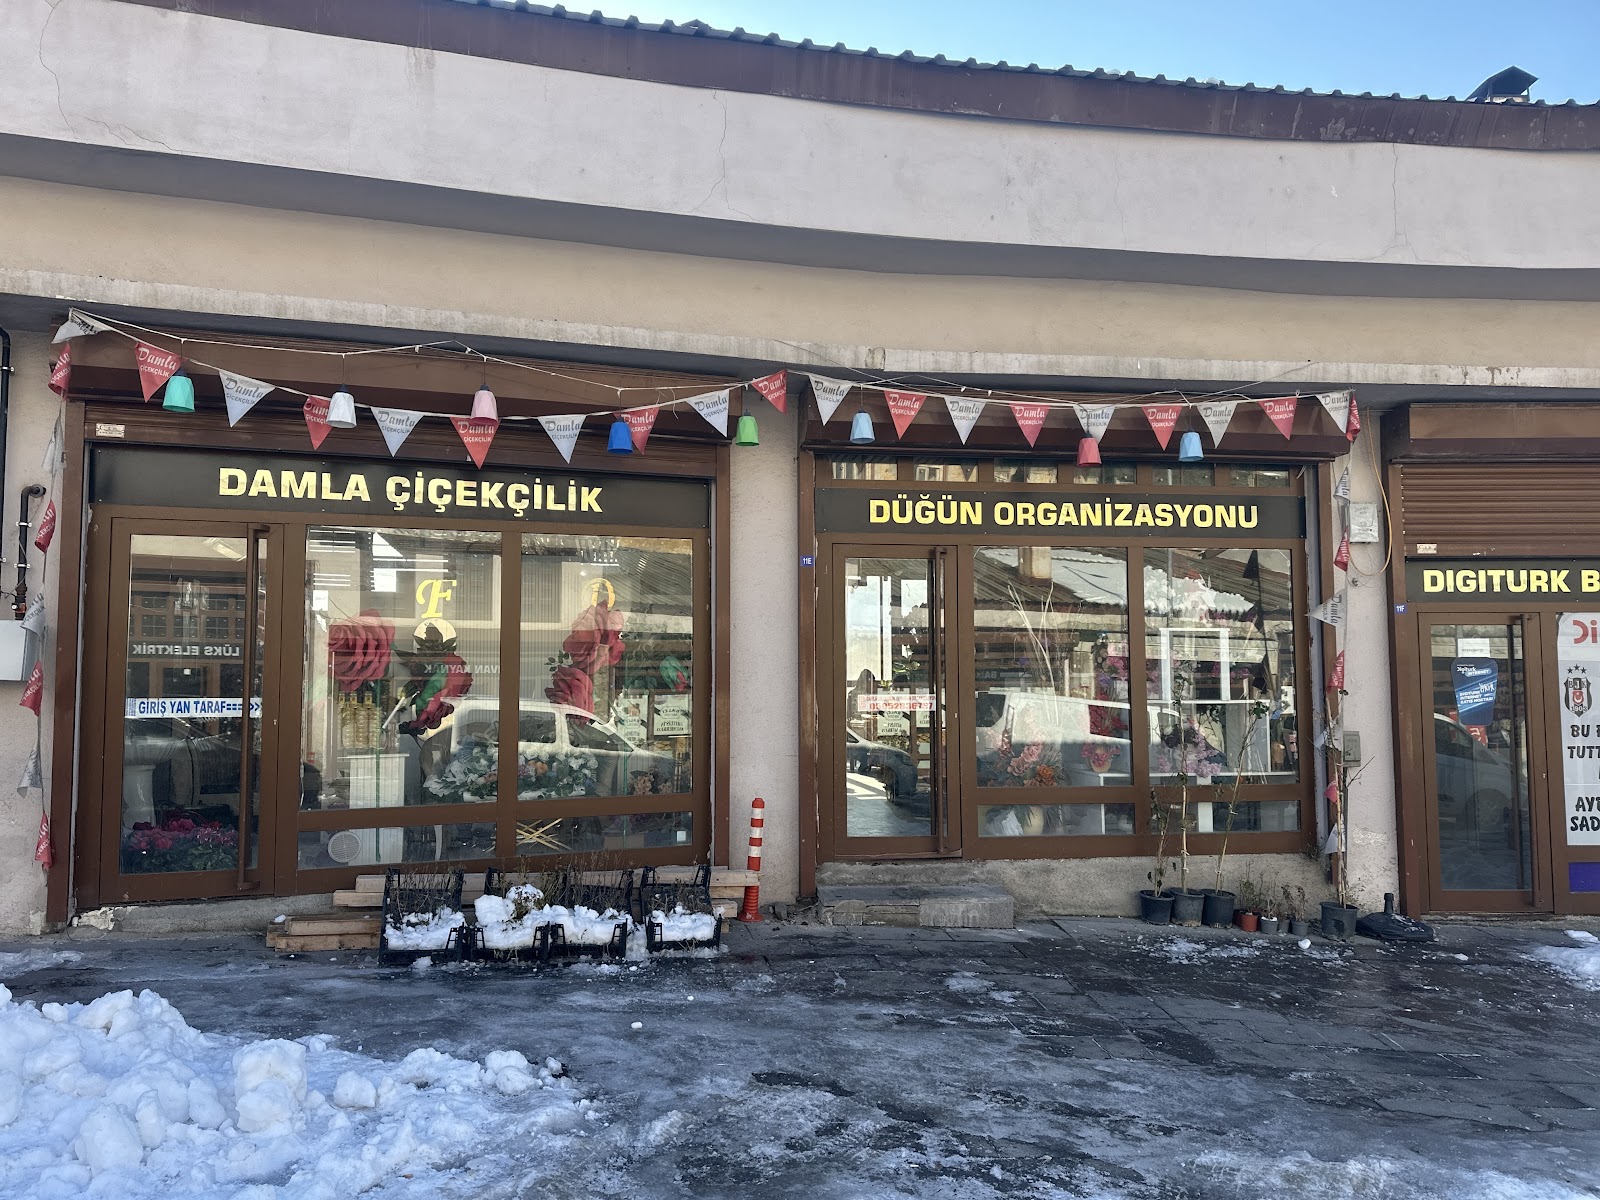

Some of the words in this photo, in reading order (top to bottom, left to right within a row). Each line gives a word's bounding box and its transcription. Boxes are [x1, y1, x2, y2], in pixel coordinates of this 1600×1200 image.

[138, 347, 177, 371] Damla
[225, 377, 265, 399] Damla
[814, 380, 845, 397] Damla
[303, 397, 329, 416] Dam
[695, 395, 728, 412] Damla
[889, 393, 920, 409] Damla
[950, 400, 980, 414] Damla
[1263, 401, 1295, 413] Damla
[377, 410, 416, 427] Damla
[1014, 405, 1046, 419] Damla
[1148, 408, 1177, 420] Damla
[1203, 406, 1232, 418] Damla
[457, 421, 495, 434] Damla
[545, 420, 580, 432] Damla
[219, 467, 370, 502] DAMLA
[386, 471, 603, 517] ÇİÇEKÇİLİK
[869, 493, 982, 525] DÜĞÜN
[994, 497, 1258, 528] ORGANİZASYONU
[802, 557, 812, 565] 11E
[1423, 569, 1571, 593] DIGITURK
[416, 579, 457, 619] F
[170, 700, 191, 714] YAN
[1570, 724, 1591, 738] BU
[1570, 815, 1600, 832] SAD
